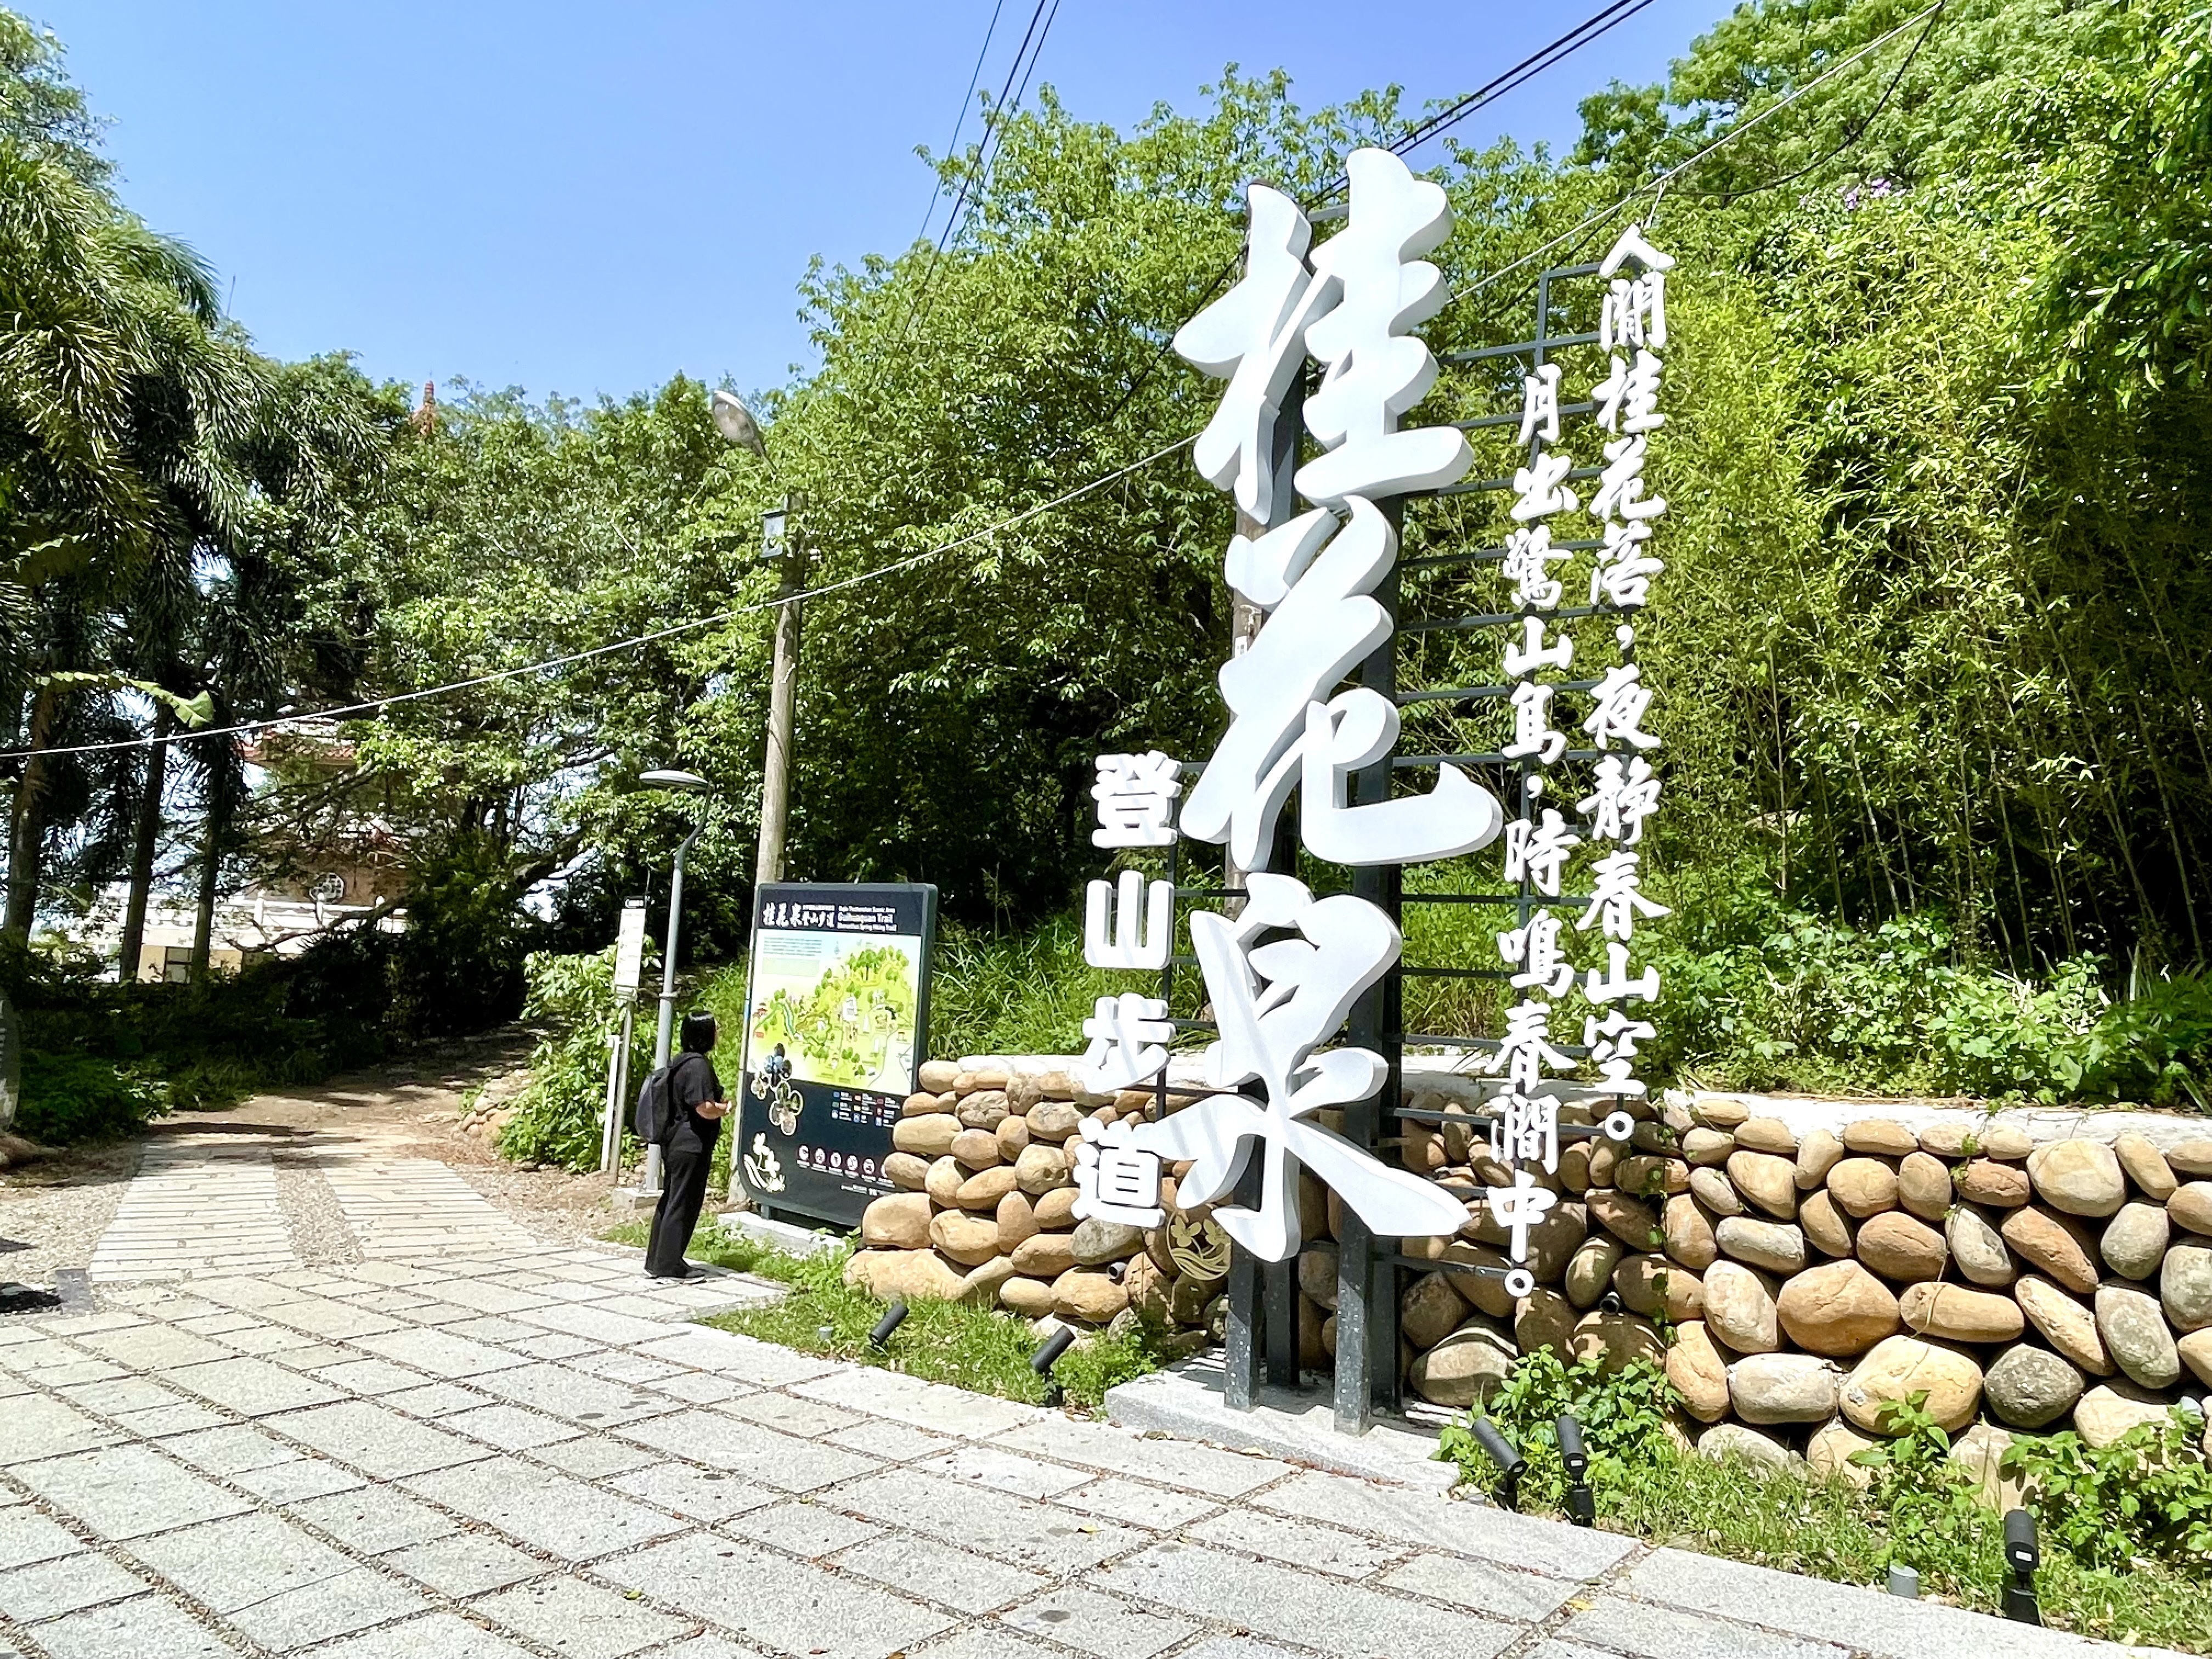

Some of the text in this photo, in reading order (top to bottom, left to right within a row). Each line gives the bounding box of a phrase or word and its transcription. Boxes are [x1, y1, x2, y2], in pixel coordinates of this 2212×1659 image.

[1071, 751, 1183, 1228] 登山步道
[1141, 148, 1502, 1263] 桂花泉
